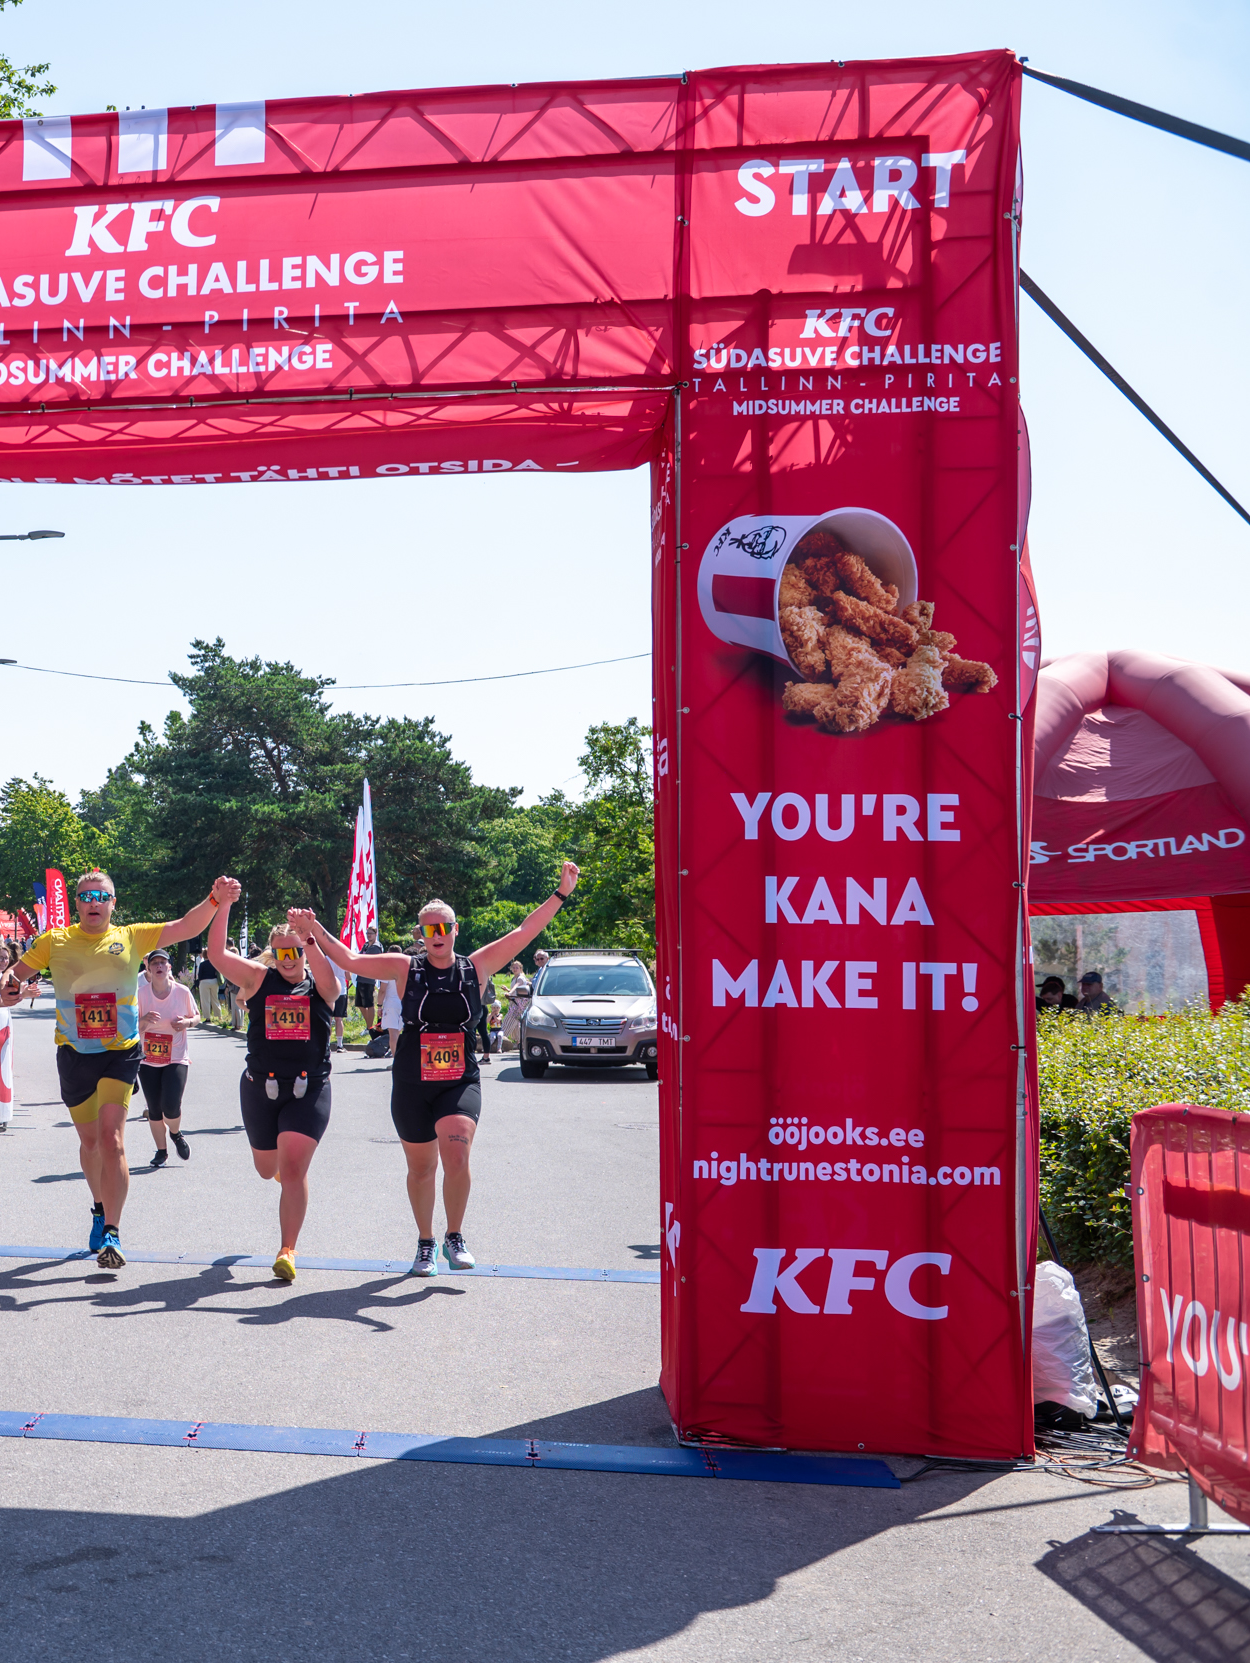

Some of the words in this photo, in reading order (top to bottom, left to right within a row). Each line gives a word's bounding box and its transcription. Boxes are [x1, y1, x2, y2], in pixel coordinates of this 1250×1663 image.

[733, 148, 967, 218] START
[64, 195, 221, 257] KFC
[138, 249, 404, 299] CHALLENGE
[204, 299, 404, 335] PIRITA
[798, 307, 895, 339] KFC
[146, 342, 333, 379] CHALLENGE
[693, 342, 838, 370] SÜDASUVE
[844, 341, 1001, 367] CHALLENGE
[692, 375, 841, 393] TALLINN
[885, 372, 1002, 389] PIRITA
[733, 399, 845, 416] MIDSUMMER
[850, 396, 960, 414] CHALLENGE
[230, 465, 360, 482] TÄHTI
[375, 459, 544, 475] OTSIDA
[713, 526, 732, 558] KFC
[730, 792, 961, 842] YOU'RE
[1066, 827, 1246, 864] SPORTLAND
[765, 875, 935, 926] KANA
[712, 958, 878, 1009] MAKE
[902, 961, 979, 1012] IT!
[81, 1009, 112, 1023] 1411
[271, 1011, 305, 1024] 1410
[146, 1043, 169, 1054] 1213
[426, 1049, 460, 1064] 1409
[578, 1037, 593, 1046] 447
[598, 1037, 614, 1046] TMT
[768, 1116, 924, 1151] ööjooks.ee
[693, 1151, 1001, 1186] nightrunestonia.com
[740, 1248, 952, 1320] KFC
